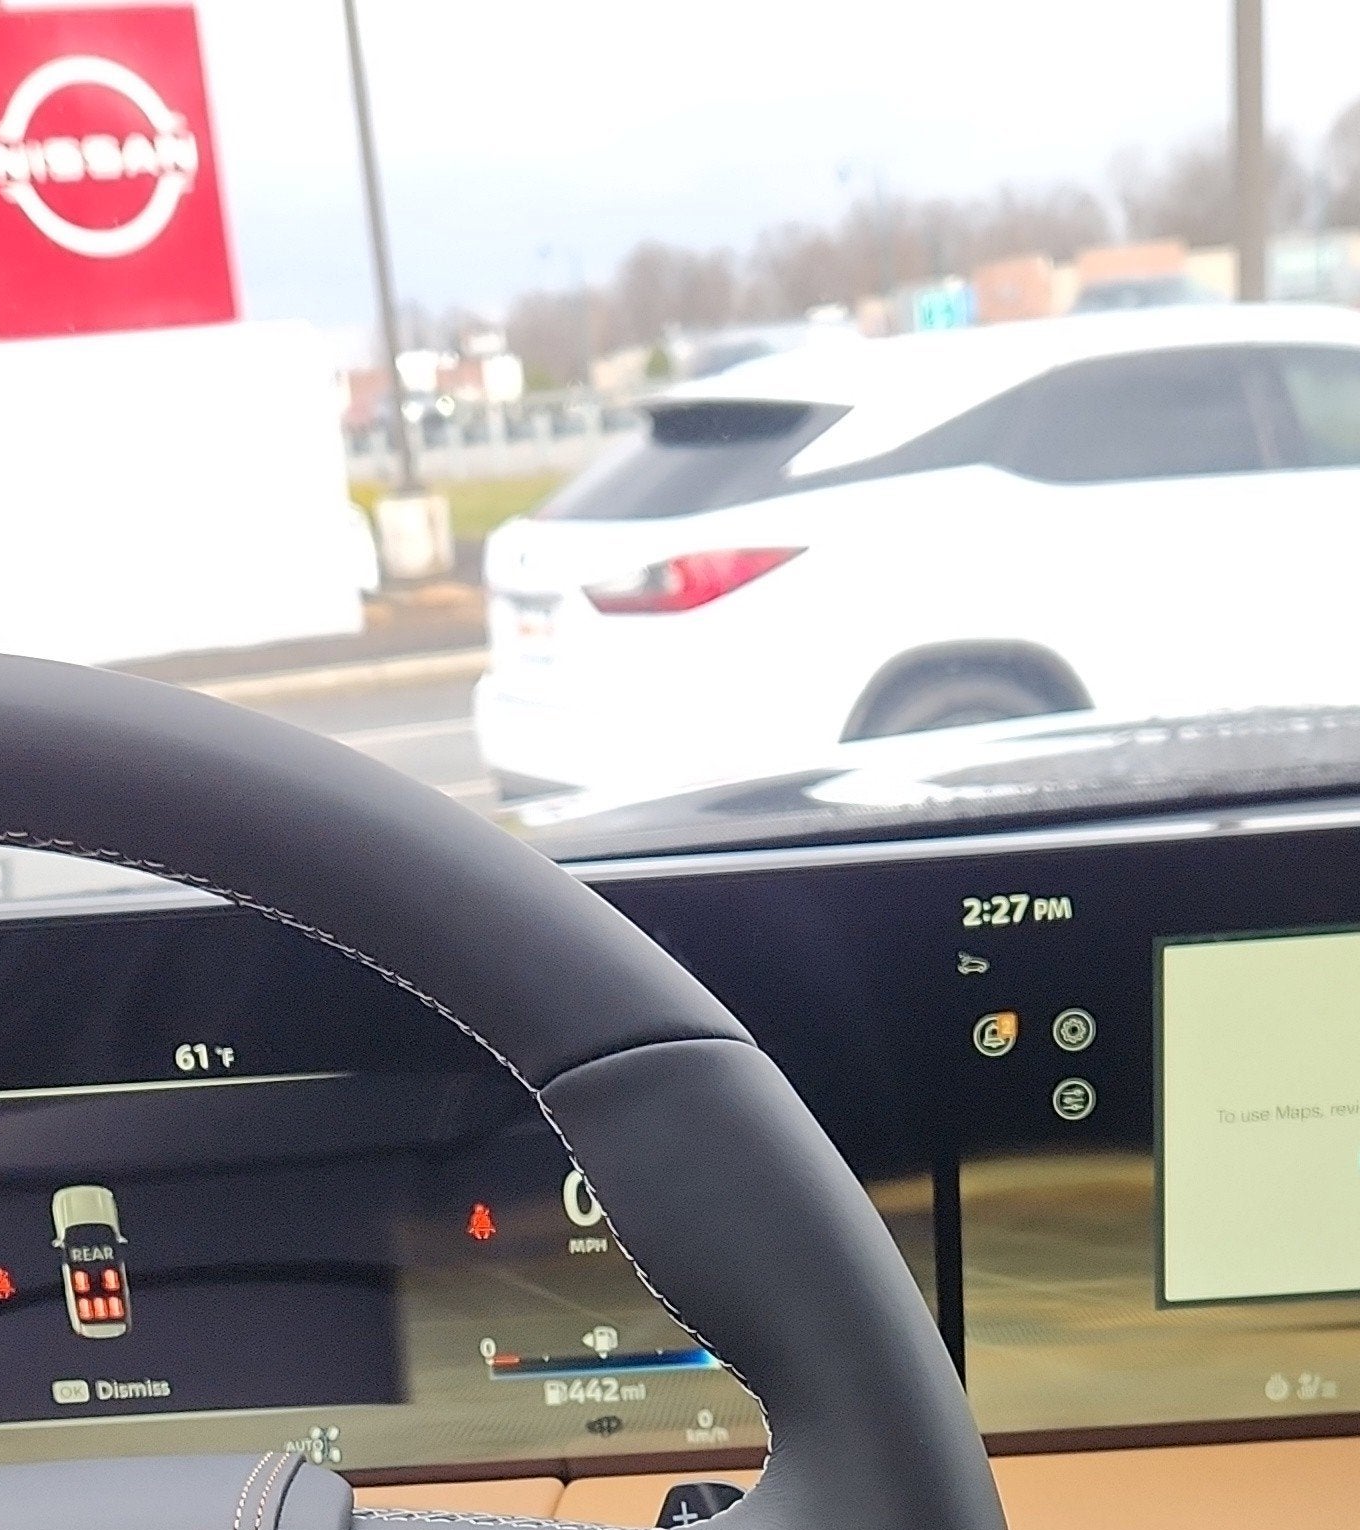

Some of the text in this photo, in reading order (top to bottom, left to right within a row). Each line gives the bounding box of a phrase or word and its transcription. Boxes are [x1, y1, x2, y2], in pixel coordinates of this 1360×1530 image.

[962, 893, 1073, 927] 2:27 PM
[175, 1043, 209, 1071] 61
[1217, 1109, 1236, 1124] To
[1240, 1109, 1271, 1122] use
[1275, 1105, 1324, 1121] Maps,
[72, 1247, 114, 1262] REAR
[570, 1238, 607, 1254] MPH
[479, 1337, 497, 1358] 0
[60, 1379, 171, 1400] OK Dismiss
[697, 1408, 713, 1428] 0
[286, 1439, 324, 1452] AUTO
